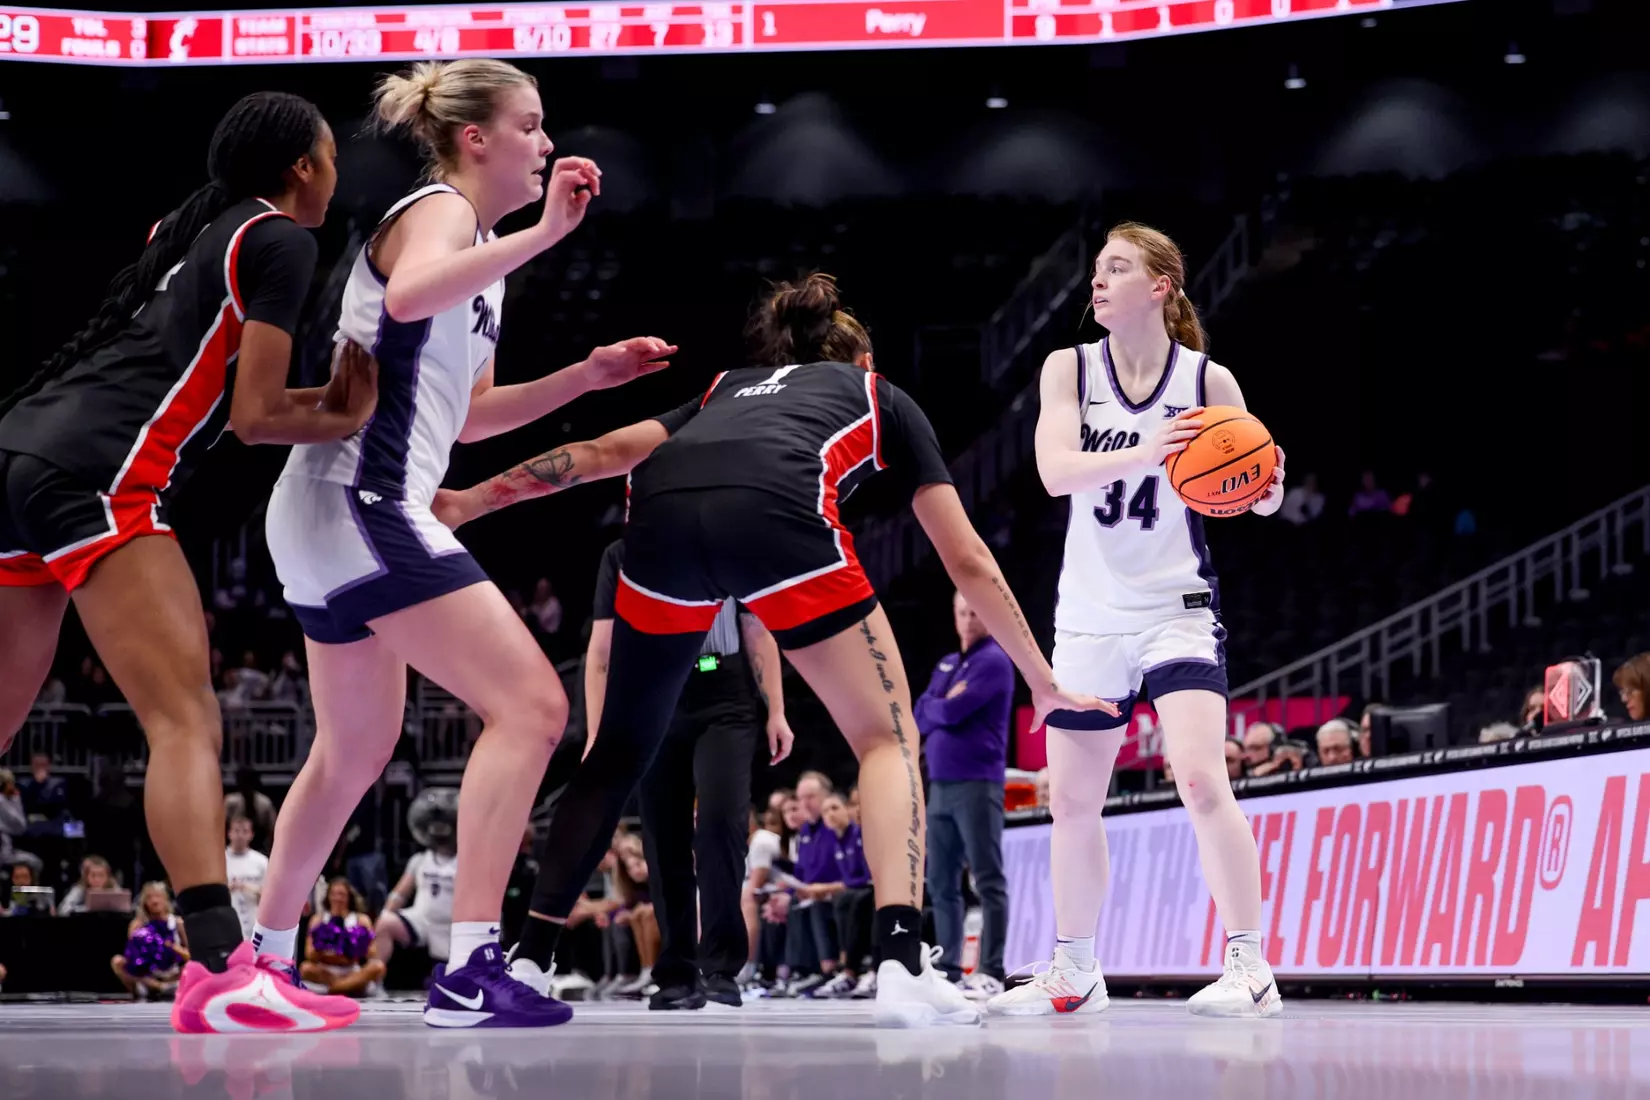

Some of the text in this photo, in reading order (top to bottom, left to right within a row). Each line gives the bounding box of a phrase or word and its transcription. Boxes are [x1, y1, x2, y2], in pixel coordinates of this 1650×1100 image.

[762, 9, 927, 36] 1 Perry
[734, 384, 787, 398] PERRY
[1220, 464, 1260, 494] EVO
[1094, 475, 1159, 531] 34
